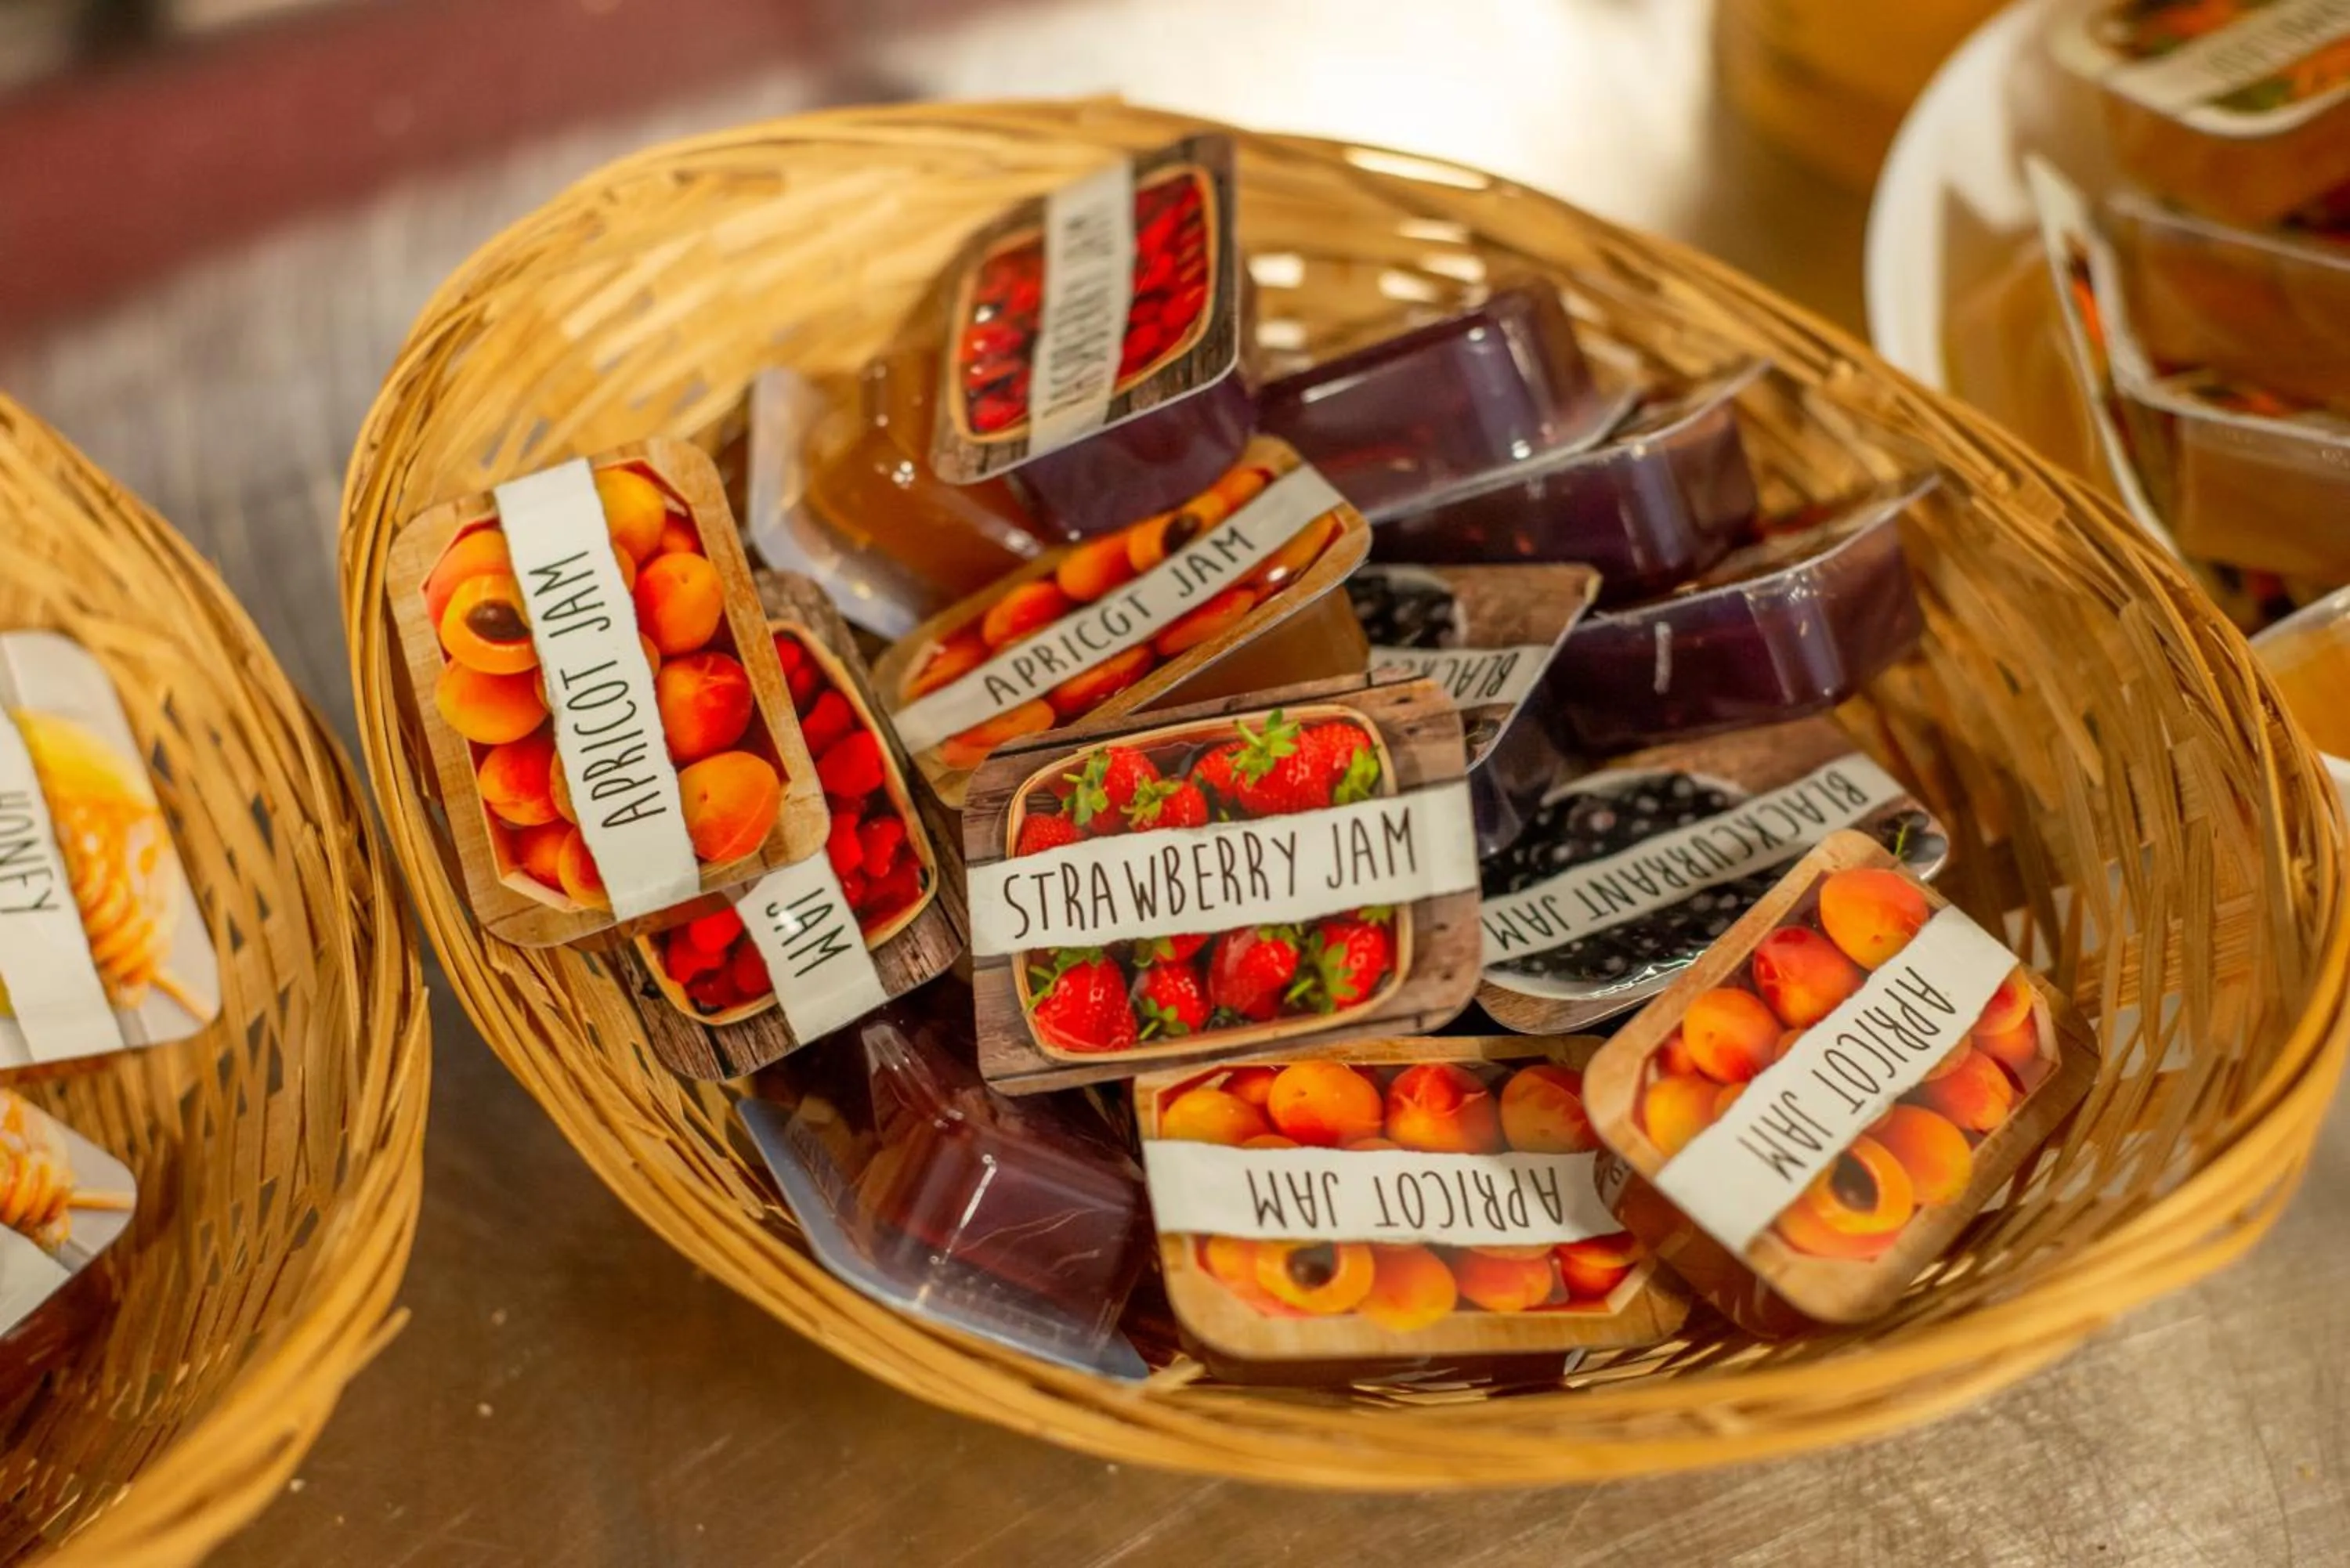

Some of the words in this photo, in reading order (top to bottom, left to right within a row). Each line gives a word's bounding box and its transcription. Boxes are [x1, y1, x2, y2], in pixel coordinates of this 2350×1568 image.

[528, 550, 612, 639] JAM
[1171, 526, 1256, 599] JAM
[559, 659, 667, 830] APRICOT
[1003, 829, 1297, 940] STRAWBERRY
[1325, 807, 1419, 891] JAM
[1572, 770, 1869, 921] BLACKCURRANT
[765, 887, 853, 977] JAM
[1480, 894, 1571, 951] JAM
[1811, 966, 1956, 1116] APRICOT
[1737, 1091, 1834, 1183] JAM
[1246, 1168, 1339, 1230] JAM
[1374, 1166, 1564, 1232] APRICOT
